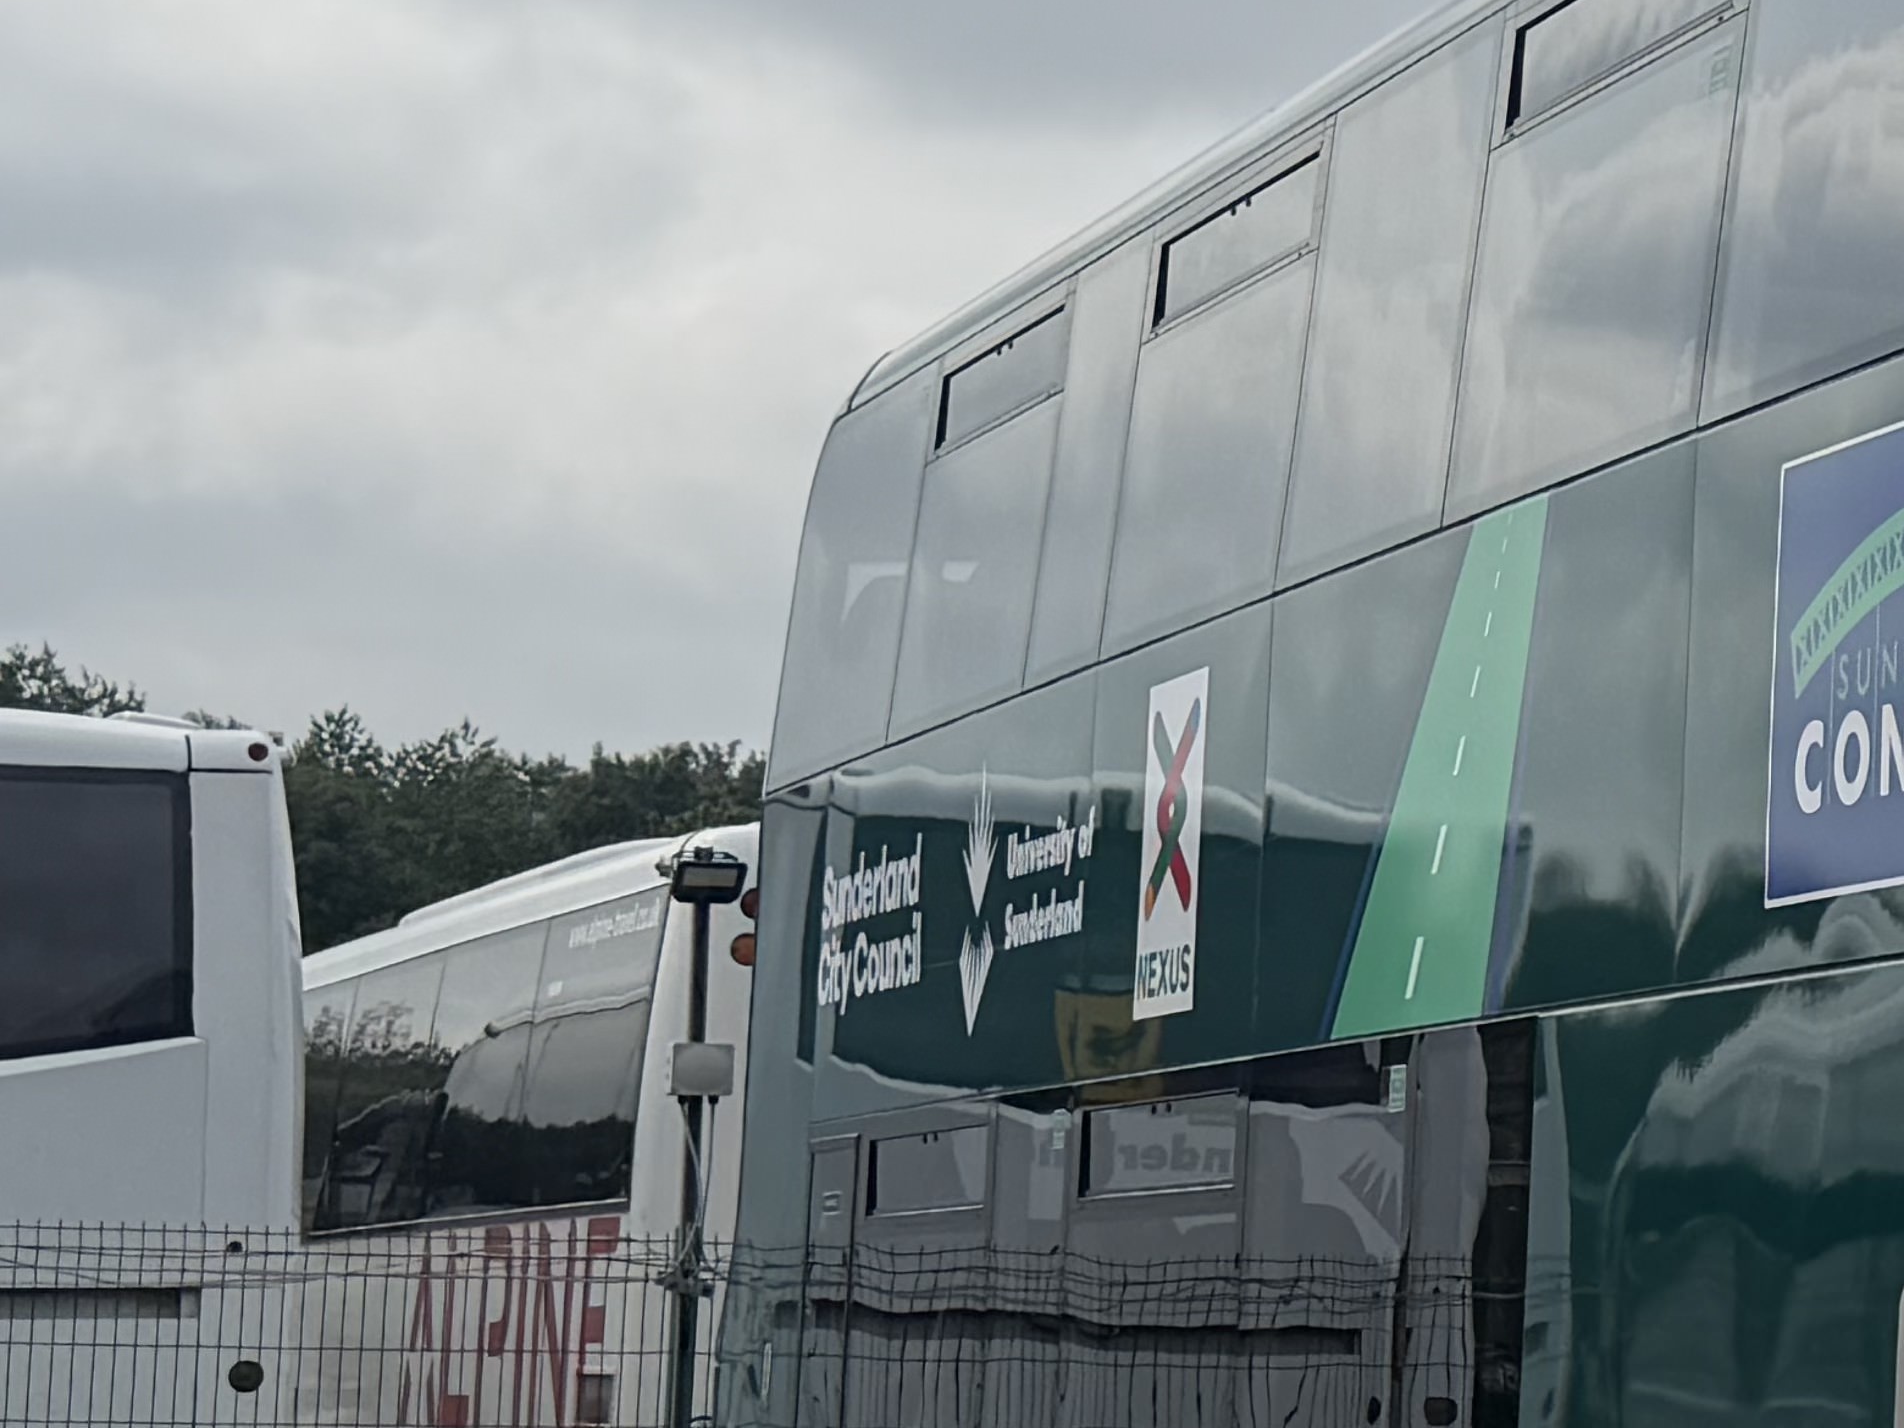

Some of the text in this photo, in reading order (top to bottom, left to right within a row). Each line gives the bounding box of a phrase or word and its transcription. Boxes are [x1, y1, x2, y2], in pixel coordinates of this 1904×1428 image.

[1006, 804, 1096, 880] University of
[821, 832, 923, 932] Sunderland
[1004, 879, 1085, 950] Sunderland
[817, 910, 923, 1016] City Council
[1136, 942, 1192, 1001] NEXUS
